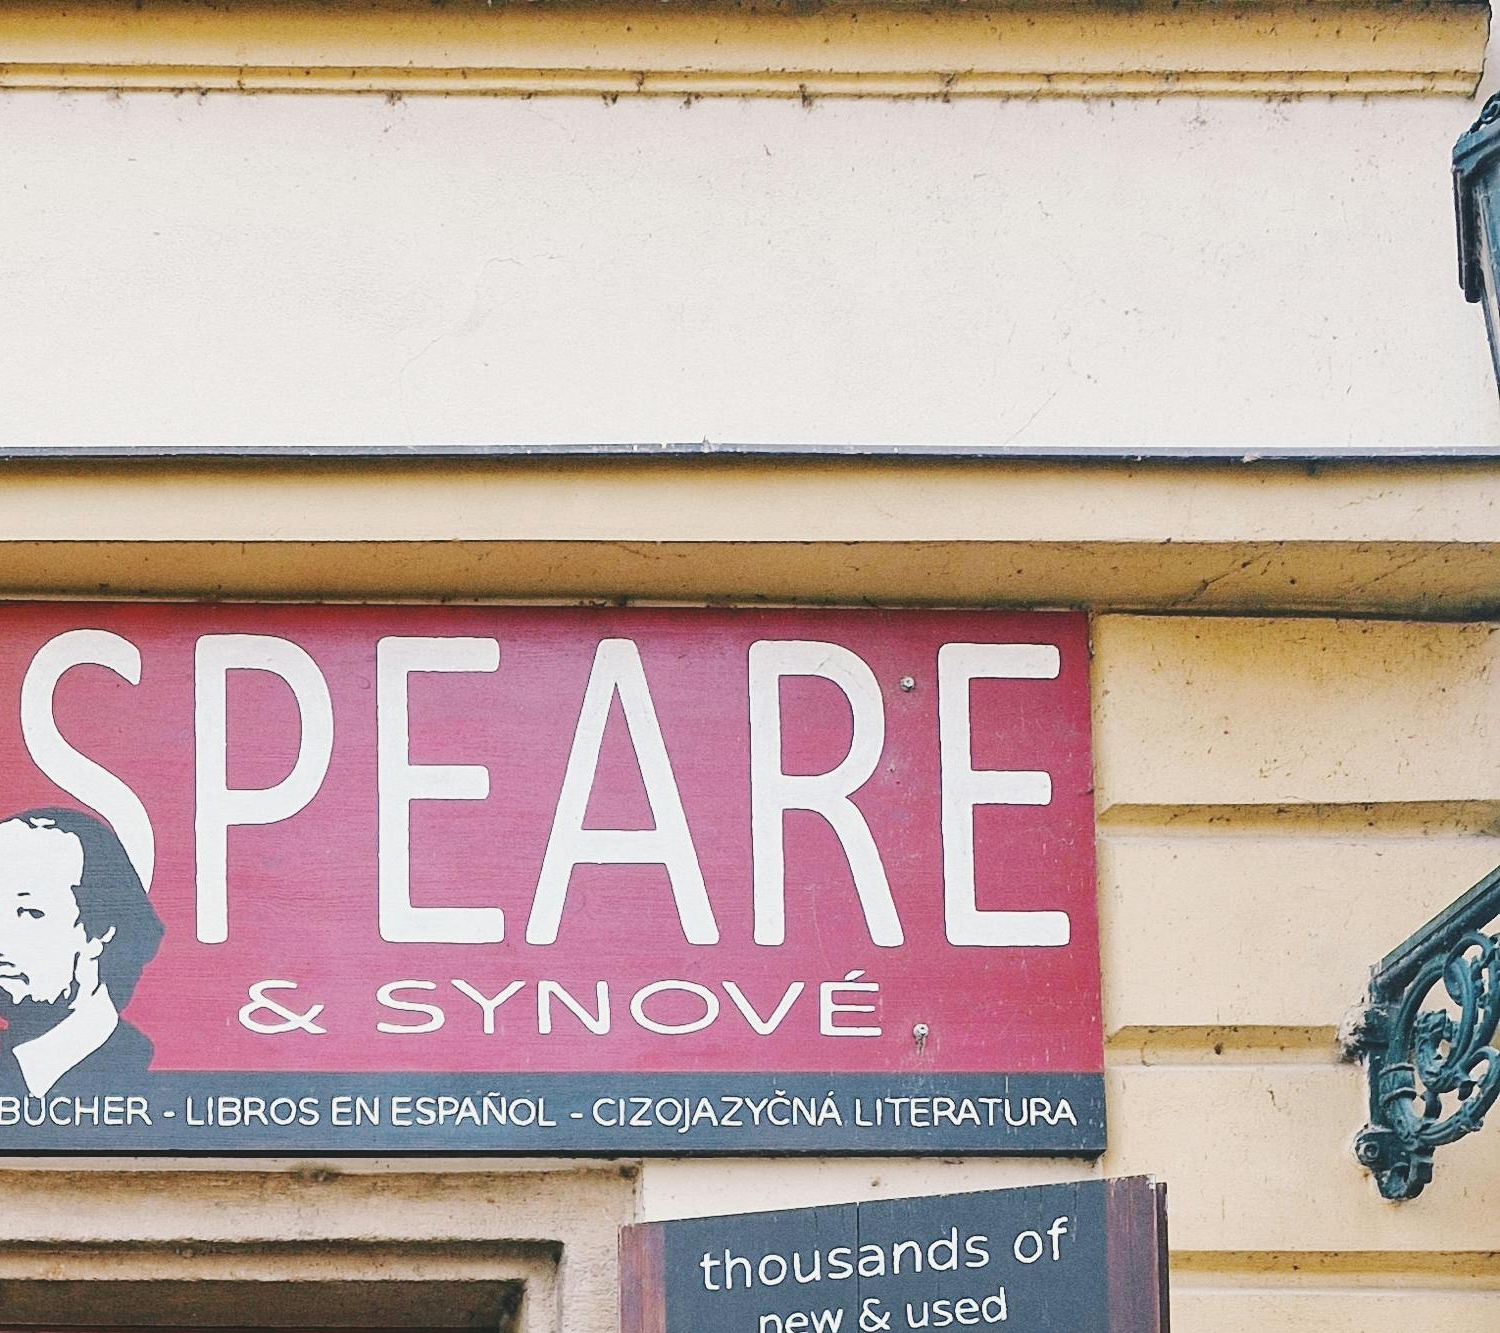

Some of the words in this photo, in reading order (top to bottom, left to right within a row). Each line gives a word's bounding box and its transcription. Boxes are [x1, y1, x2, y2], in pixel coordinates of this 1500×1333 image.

[237, 980, 326, 1035] &
[377, 969, 883, 1039] SYNOVÉ
[20, 1092, 150, 1128] BÜCHER
[185, 1095, 323, 1128] LIBROS
[333, 1095, 380, 1127] EN
[390, 1088, 556, 1128] ESPAÑOL
[591, 1088, 841, 1132] CIZOJAZYČNÁ
[854, 1096, 1077, 1129] LITERATURA
[699, 1226, 990, 1292] thousands
[1013, 1216, 1069, 1264] of
[858, 1297, 891, 1333] &
[906, 1287, 1008, 1329] used
